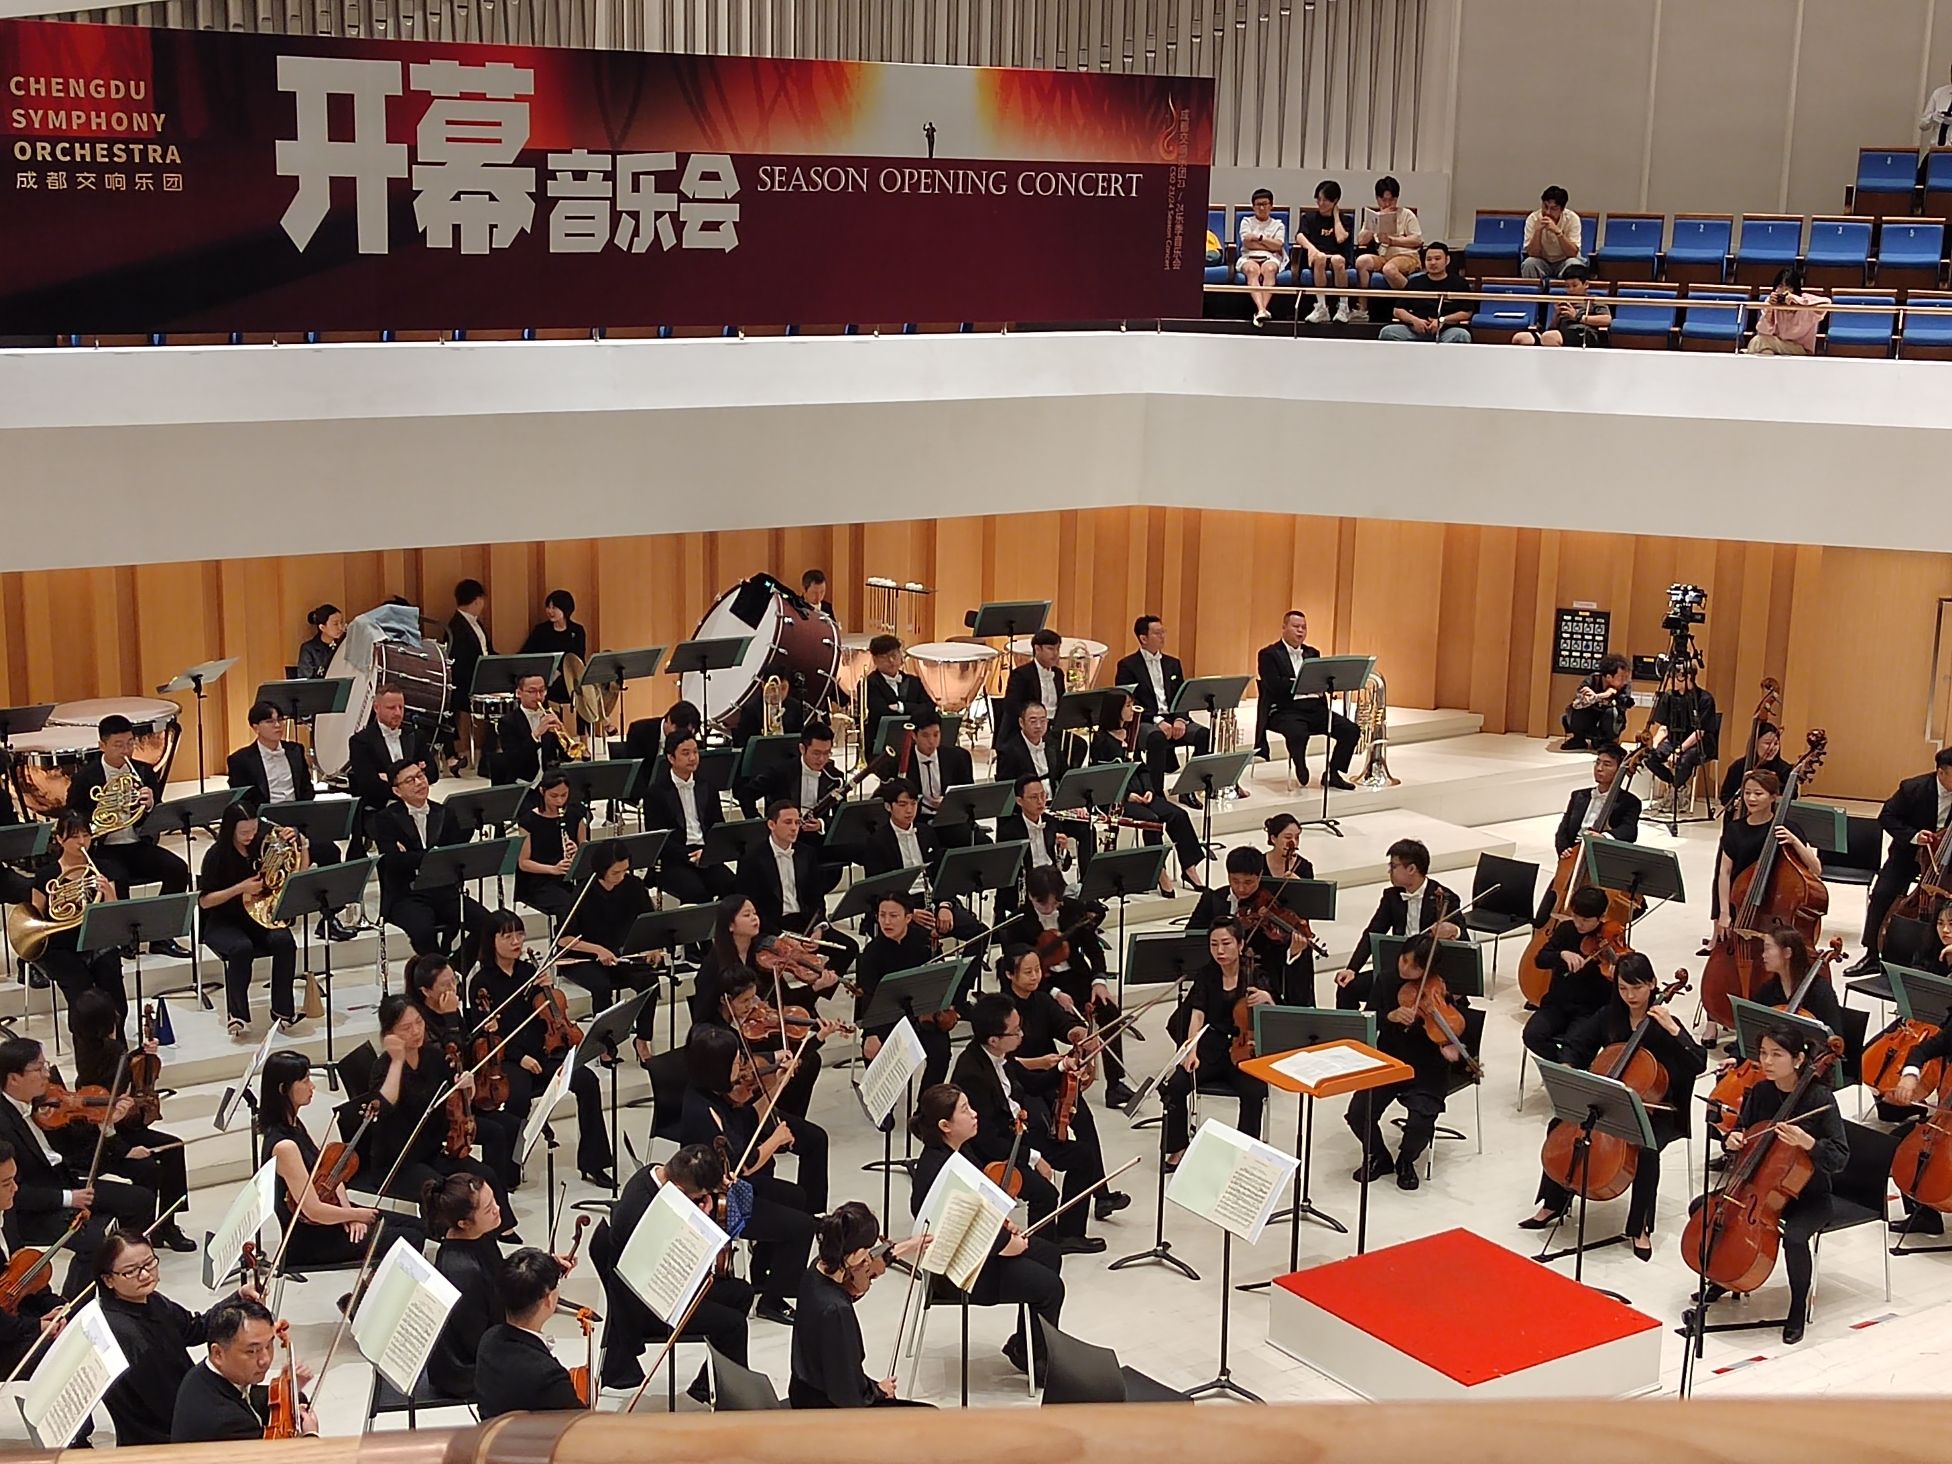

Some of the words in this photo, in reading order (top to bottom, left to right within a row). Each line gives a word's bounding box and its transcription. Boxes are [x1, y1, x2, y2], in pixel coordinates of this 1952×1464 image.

[9, 76, 146, 100] CHENGDU
[12, 108, 166, 132] SYMPHONY
[13, 141, 182, 164] ORCHESTRA
[276, 56, 536, 254] 开幕
[547, 149, 741, 254] 音乐会
[16, 170, 184, 192] 成都交响乐团
[757, 165, 870, 193] SEASON
[879, 167, 1008, 195] OPENING
[1016, 171, 1144, 198] CONCERT
[1163, 240, 1173, 270] Concert
